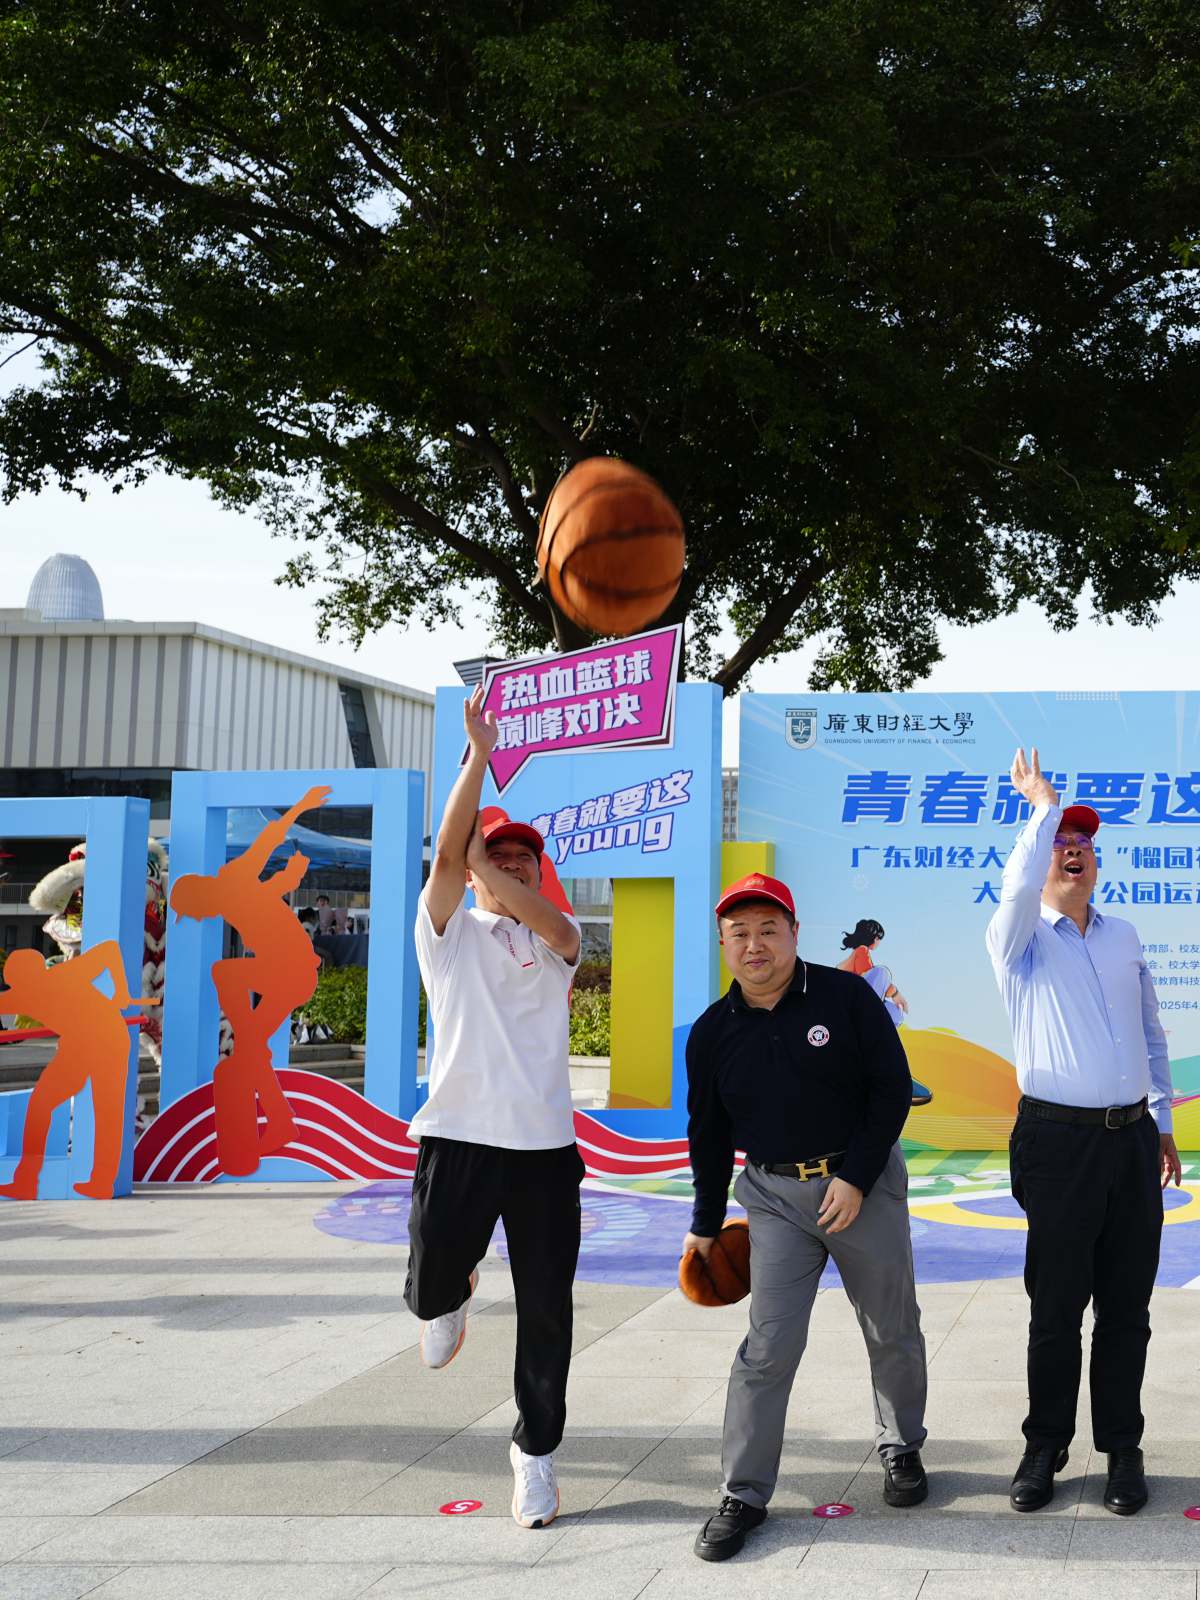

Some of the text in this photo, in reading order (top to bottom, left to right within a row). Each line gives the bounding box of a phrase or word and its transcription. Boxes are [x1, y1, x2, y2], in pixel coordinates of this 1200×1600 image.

[501, 650, 653, 711] 热血篮球
[493, 692, 643, 751] 巅峰对决
[823, 712, 975, 737] 廣東財經大學
[530, 769, 694, 839] 青春就要这
[555, 811, 675, 864] young
